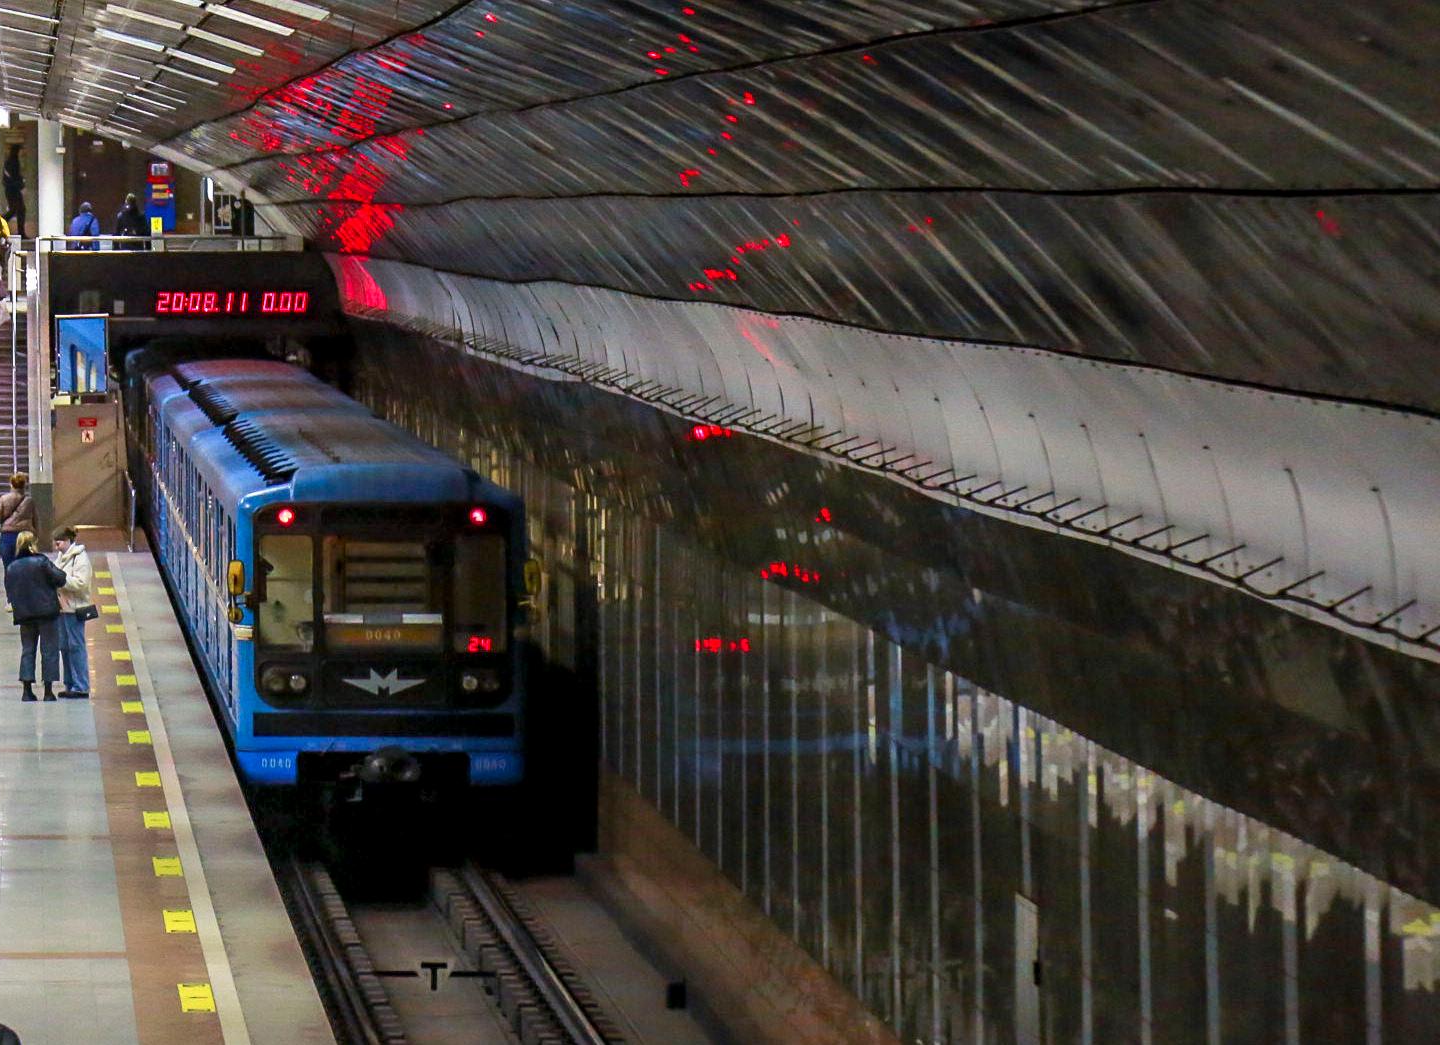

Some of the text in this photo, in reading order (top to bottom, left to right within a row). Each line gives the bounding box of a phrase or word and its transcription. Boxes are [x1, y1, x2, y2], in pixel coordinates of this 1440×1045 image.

[262, 292, 308, 312] 0.00
[365, 630, 401, 641] 0040
[467, 635, 492, 652] 24
[261, 757, 291, 769] 0040
